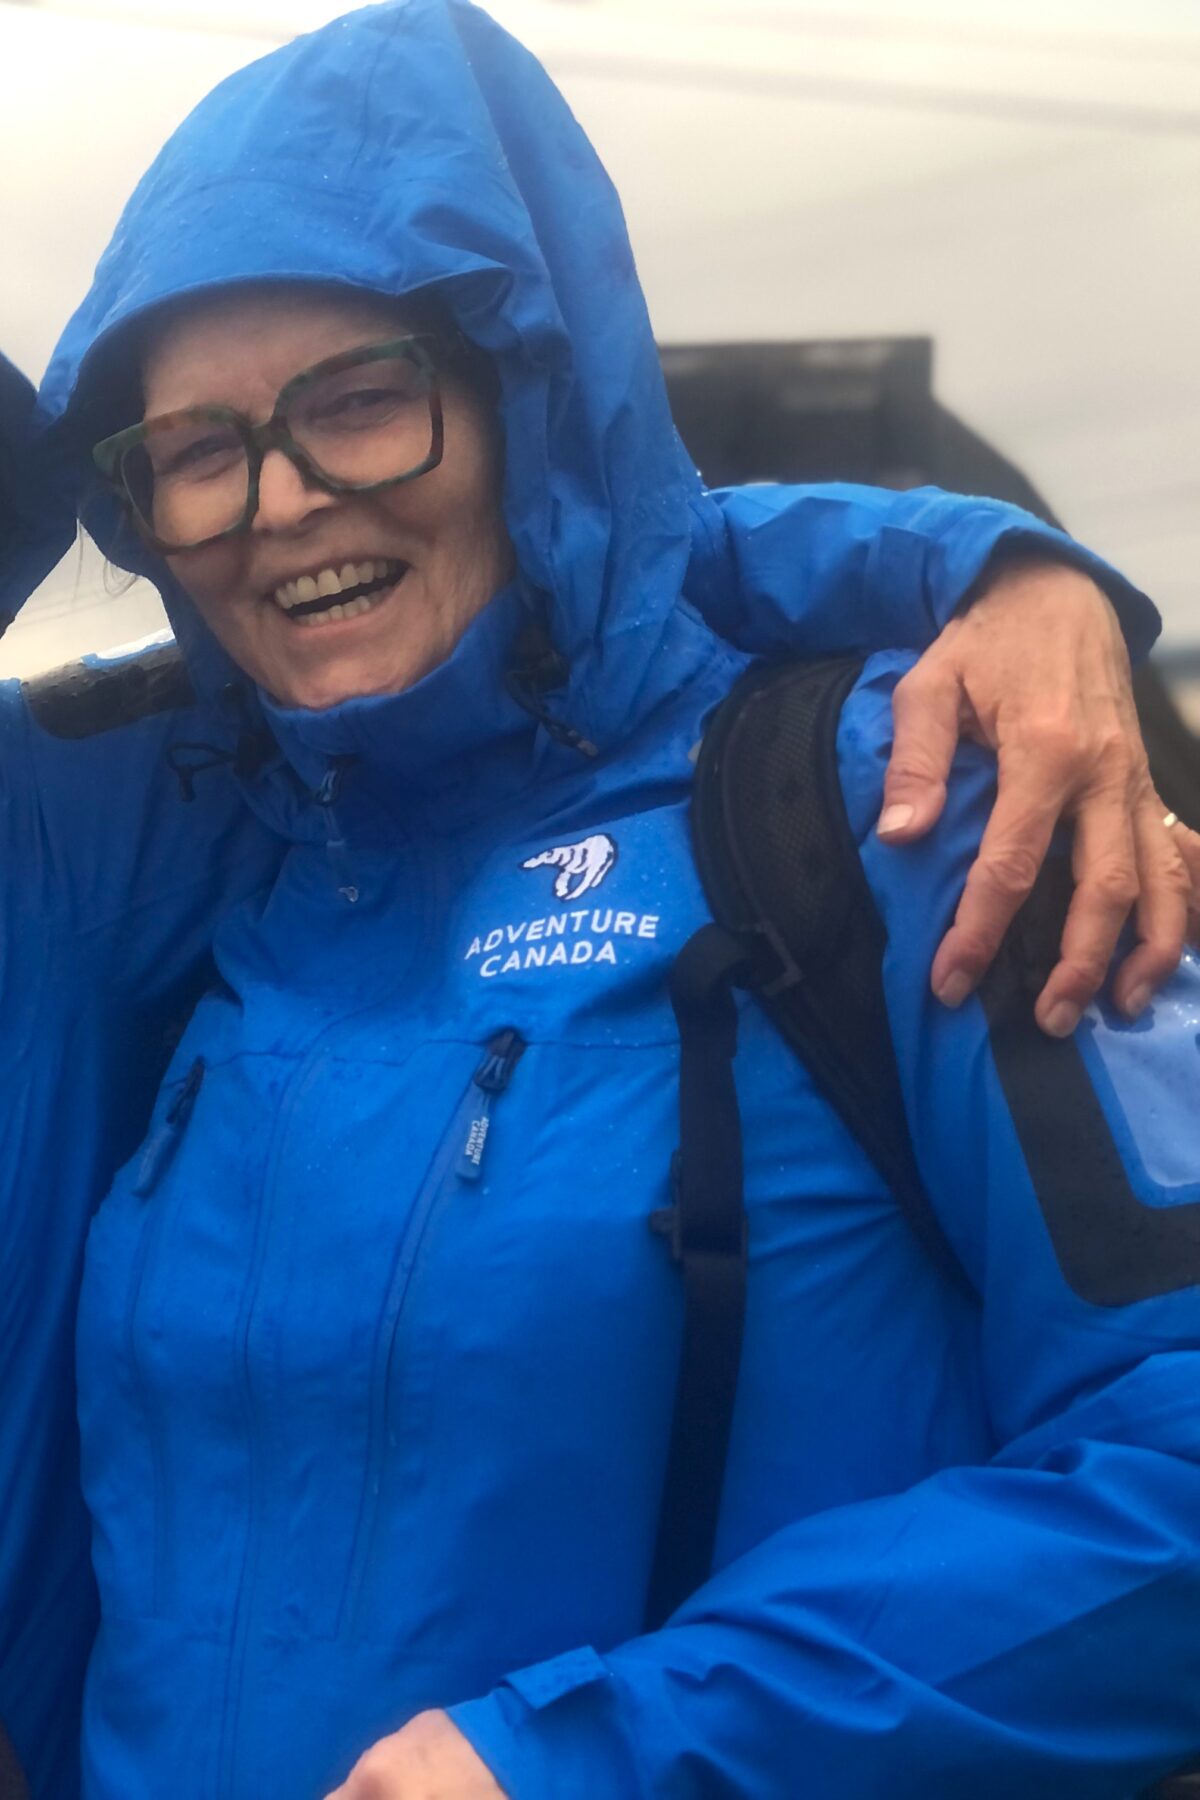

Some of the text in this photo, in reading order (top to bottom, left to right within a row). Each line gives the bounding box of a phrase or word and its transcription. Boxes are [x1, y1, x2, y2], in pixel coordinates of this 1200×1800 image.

[464, 909, 660, 960] ADVENTURE
[479, 940, 617, 978] CANADA
[465, 1120, 481, 1156] CANADA
